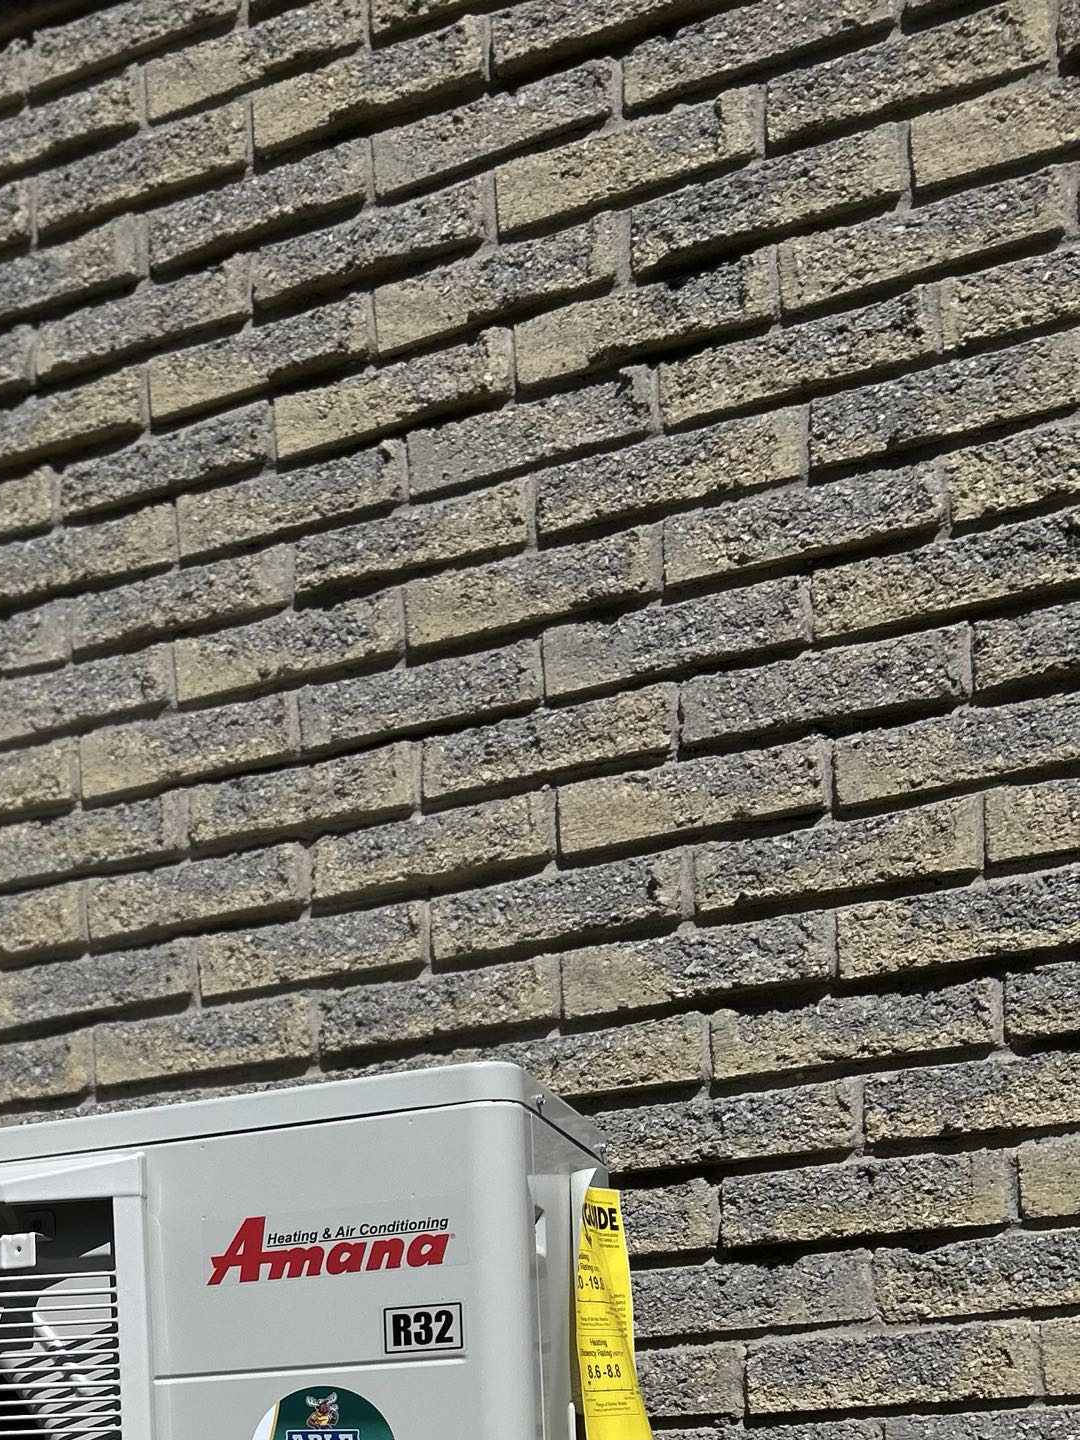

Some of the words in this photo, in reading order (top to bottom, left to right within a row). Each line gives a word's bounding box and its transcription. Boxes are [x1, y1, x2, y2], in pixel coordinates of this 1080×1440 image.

[267, 1230, 318, 1246] Heating
[322, 1228, 332, 1239] &
[335, 1226, 356, 1238] Air
[359, 1217, 449, 1236] Conditioning
[207, 1216, 450, 1286] Amana
[392, 1310, 454, 1347] R32
